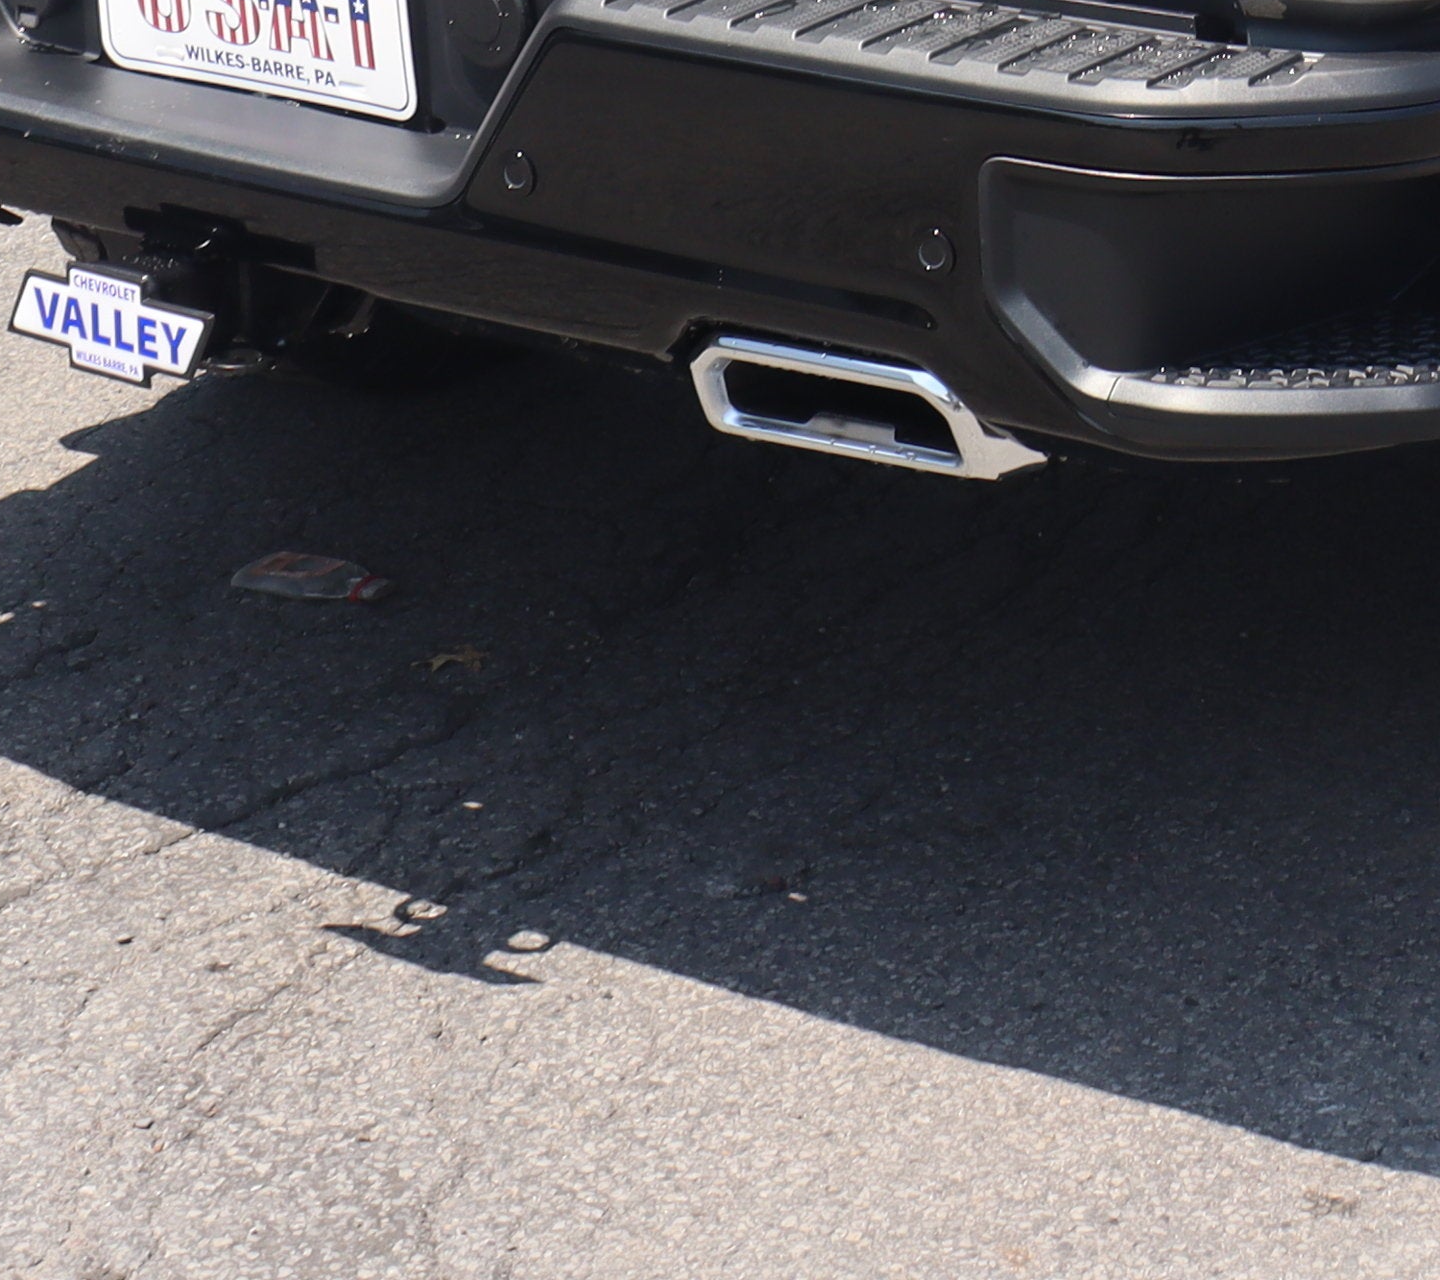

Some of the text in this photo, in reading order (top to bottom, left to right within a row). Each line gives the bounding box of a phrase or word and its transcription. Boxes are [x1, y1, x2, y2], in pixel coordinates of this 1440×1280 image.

[185, 44, 336, 88] WILKES-BARRE, PA
[73, 274, 137, 303] CHEVROLET
[34, 286, 187, 366] VALLEY
[75, 351, 102, 366] WILKES
[129, 365, 140, 377] PA
